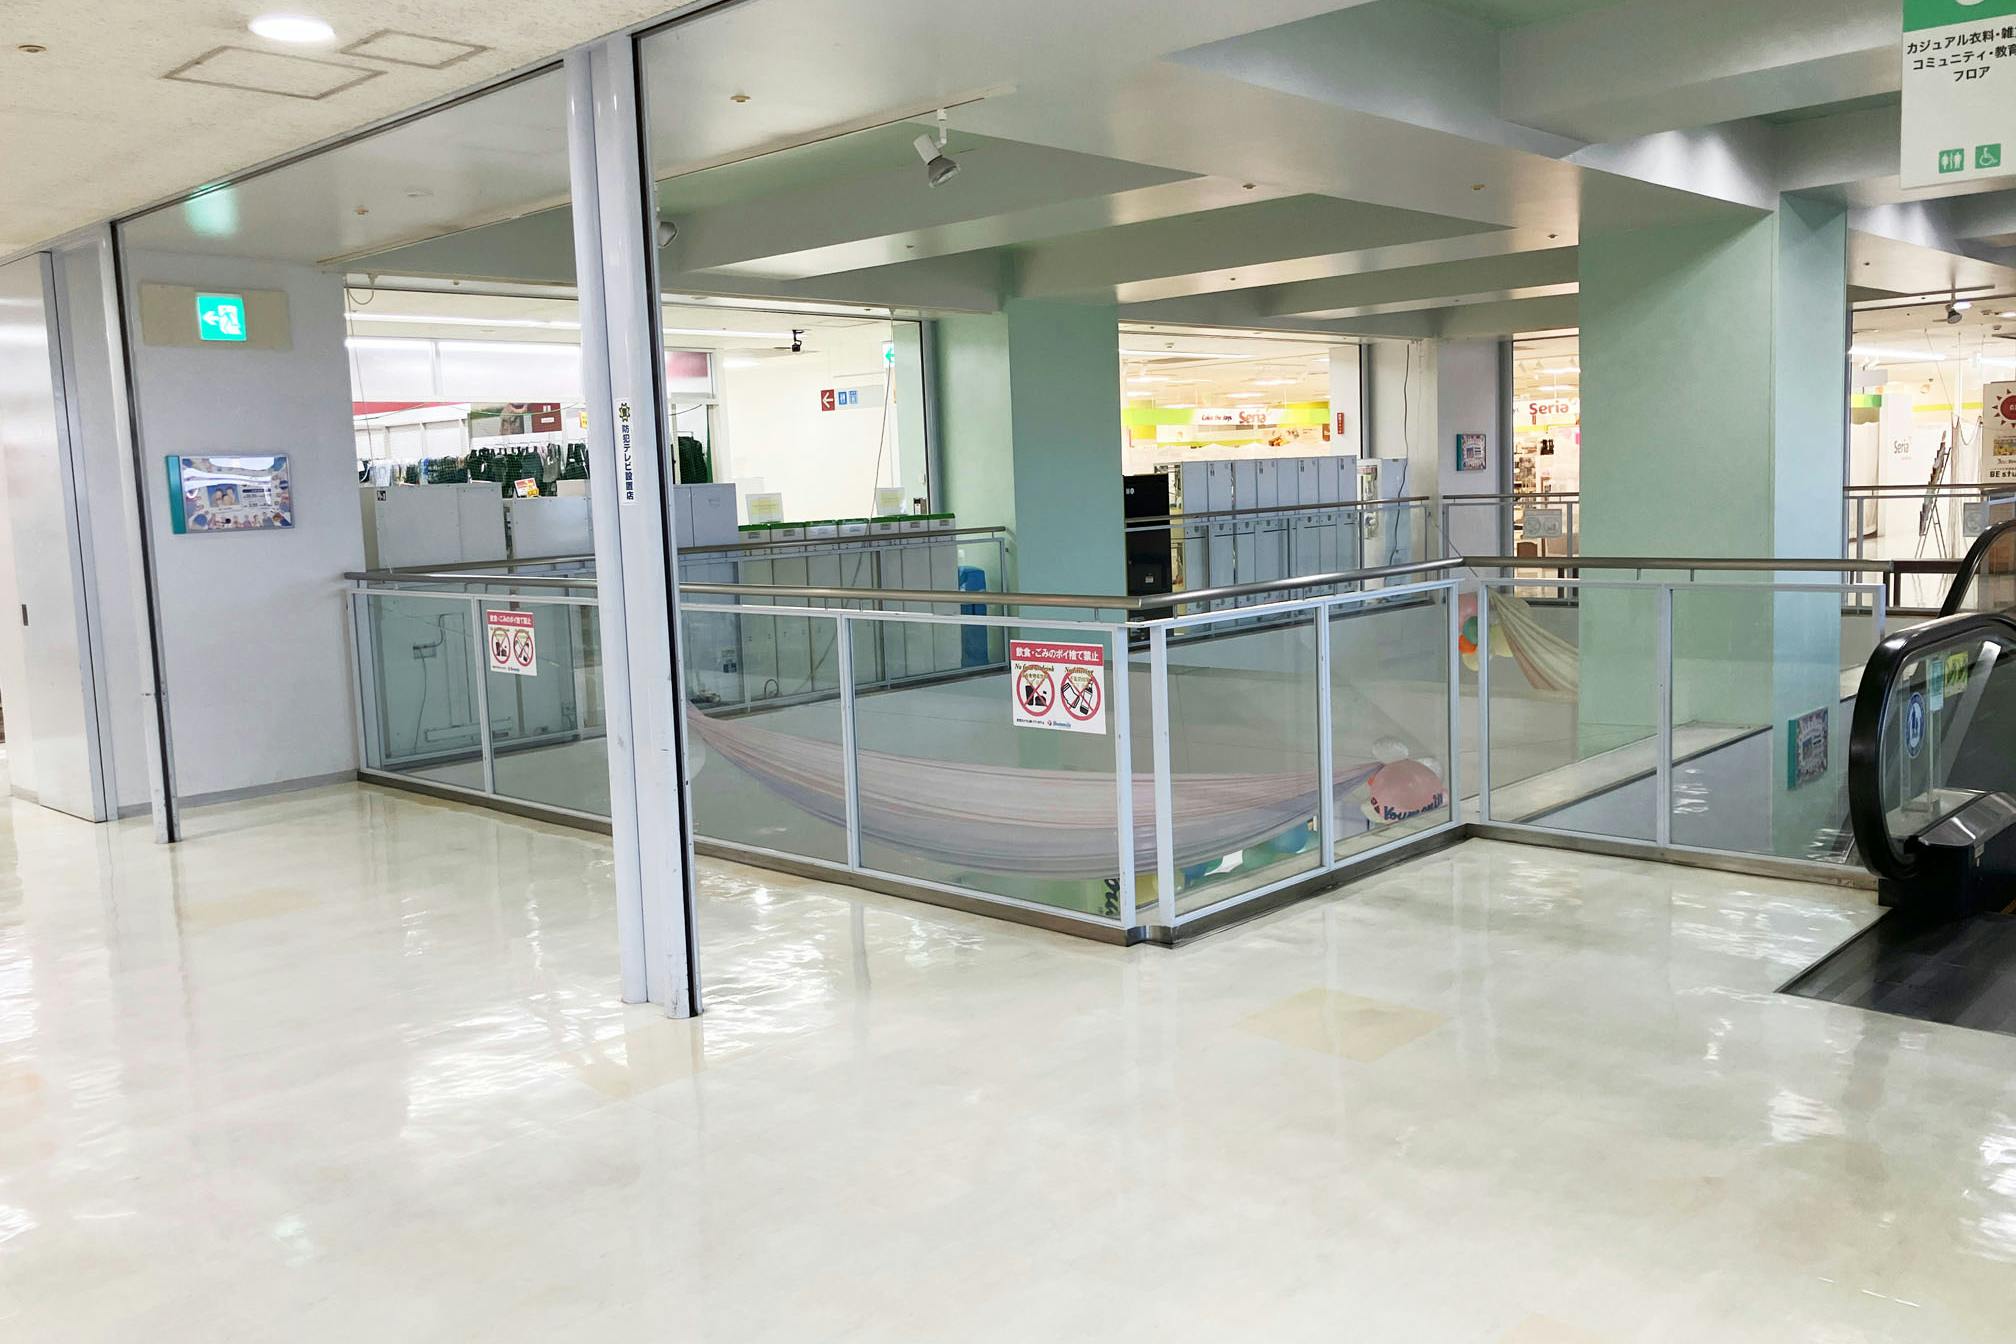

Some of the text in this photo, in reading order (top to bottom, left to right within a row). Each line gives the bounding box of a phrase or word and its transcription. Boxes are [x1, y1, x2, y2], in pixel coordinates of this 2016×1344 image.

[1907, 26, 2016, 55] カジュアル衣料・雑
[1953, 66, 1990, 82] フロア
[1529, 401, 1569, 415] Seria
[1239, 411, 1266, 423] Seria
